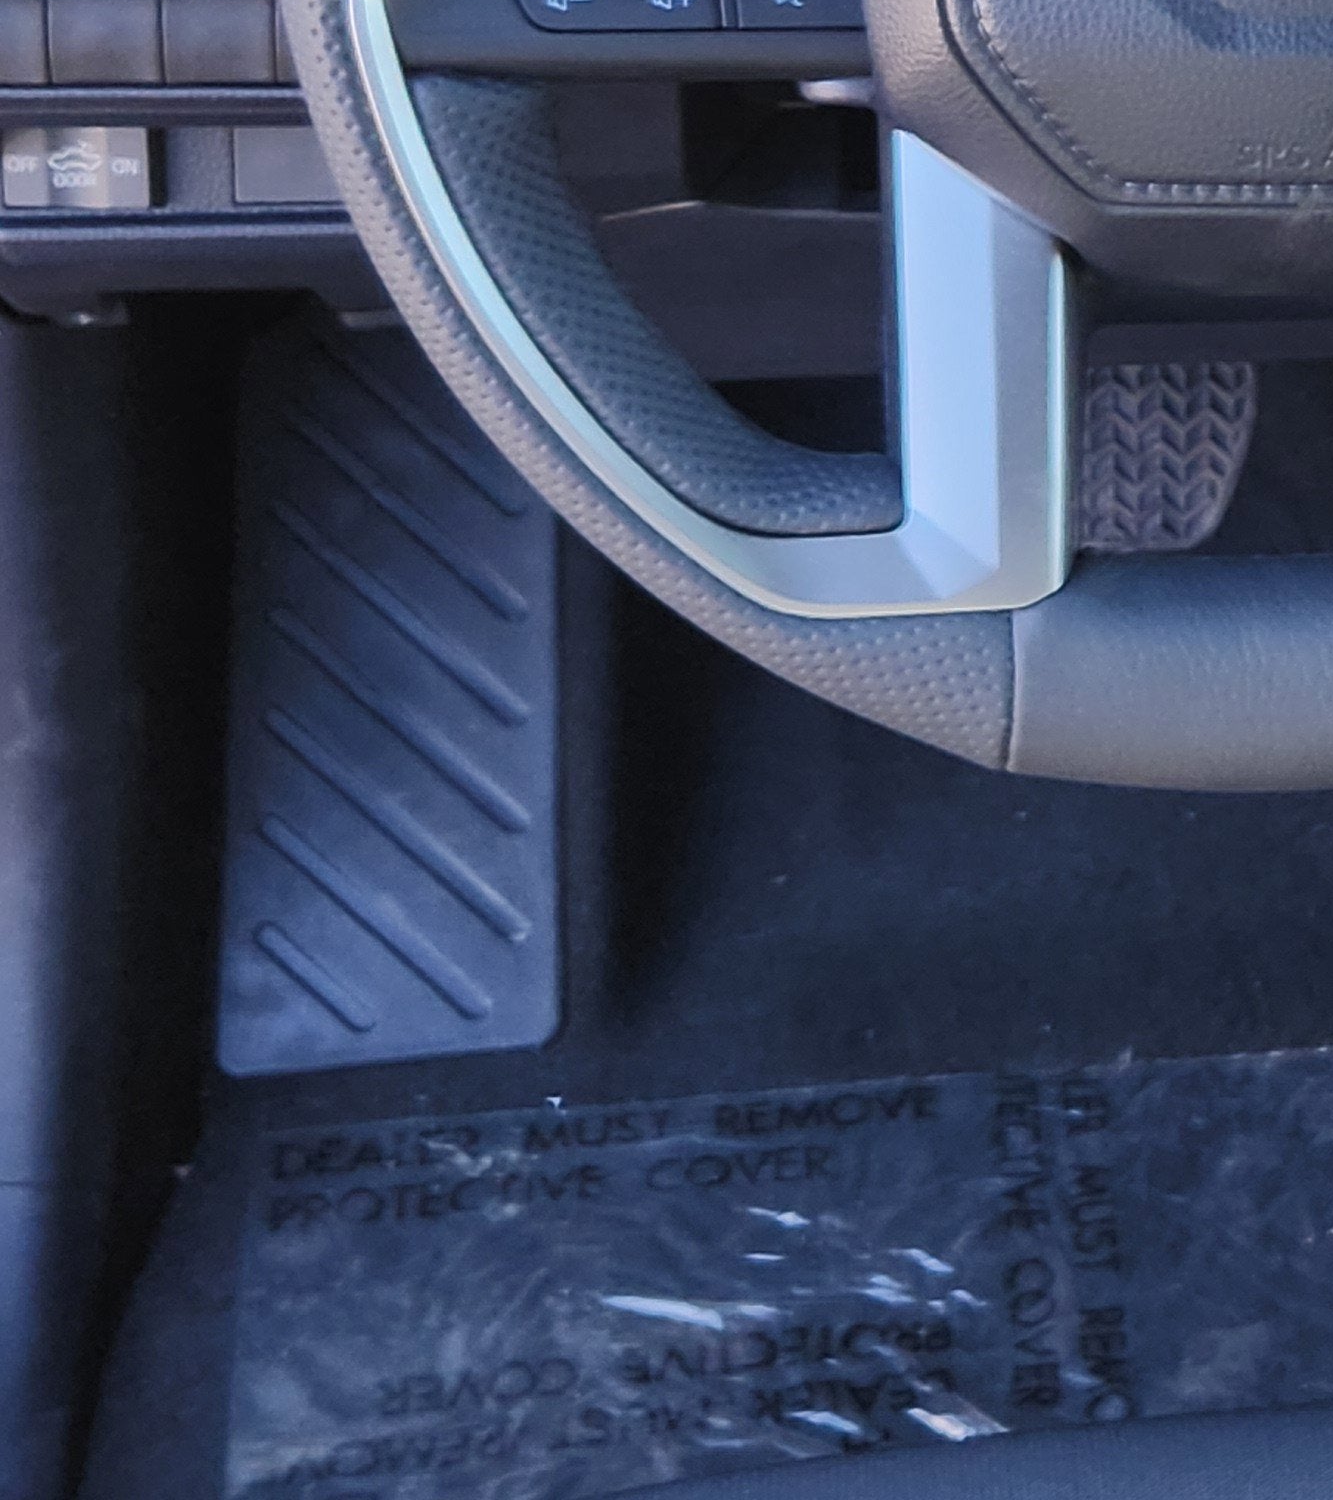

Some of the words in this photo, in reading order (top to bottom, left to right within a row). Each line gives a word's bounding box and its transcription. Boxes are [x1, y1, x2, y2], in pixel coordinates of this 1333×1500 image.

[524, 1106, 673, 1153] MUST
[714, 1085, 940, 1139] REMOVE
[645, 1145, 839, 1192] COVER
[374, 1356, 578, 1418] COVER
